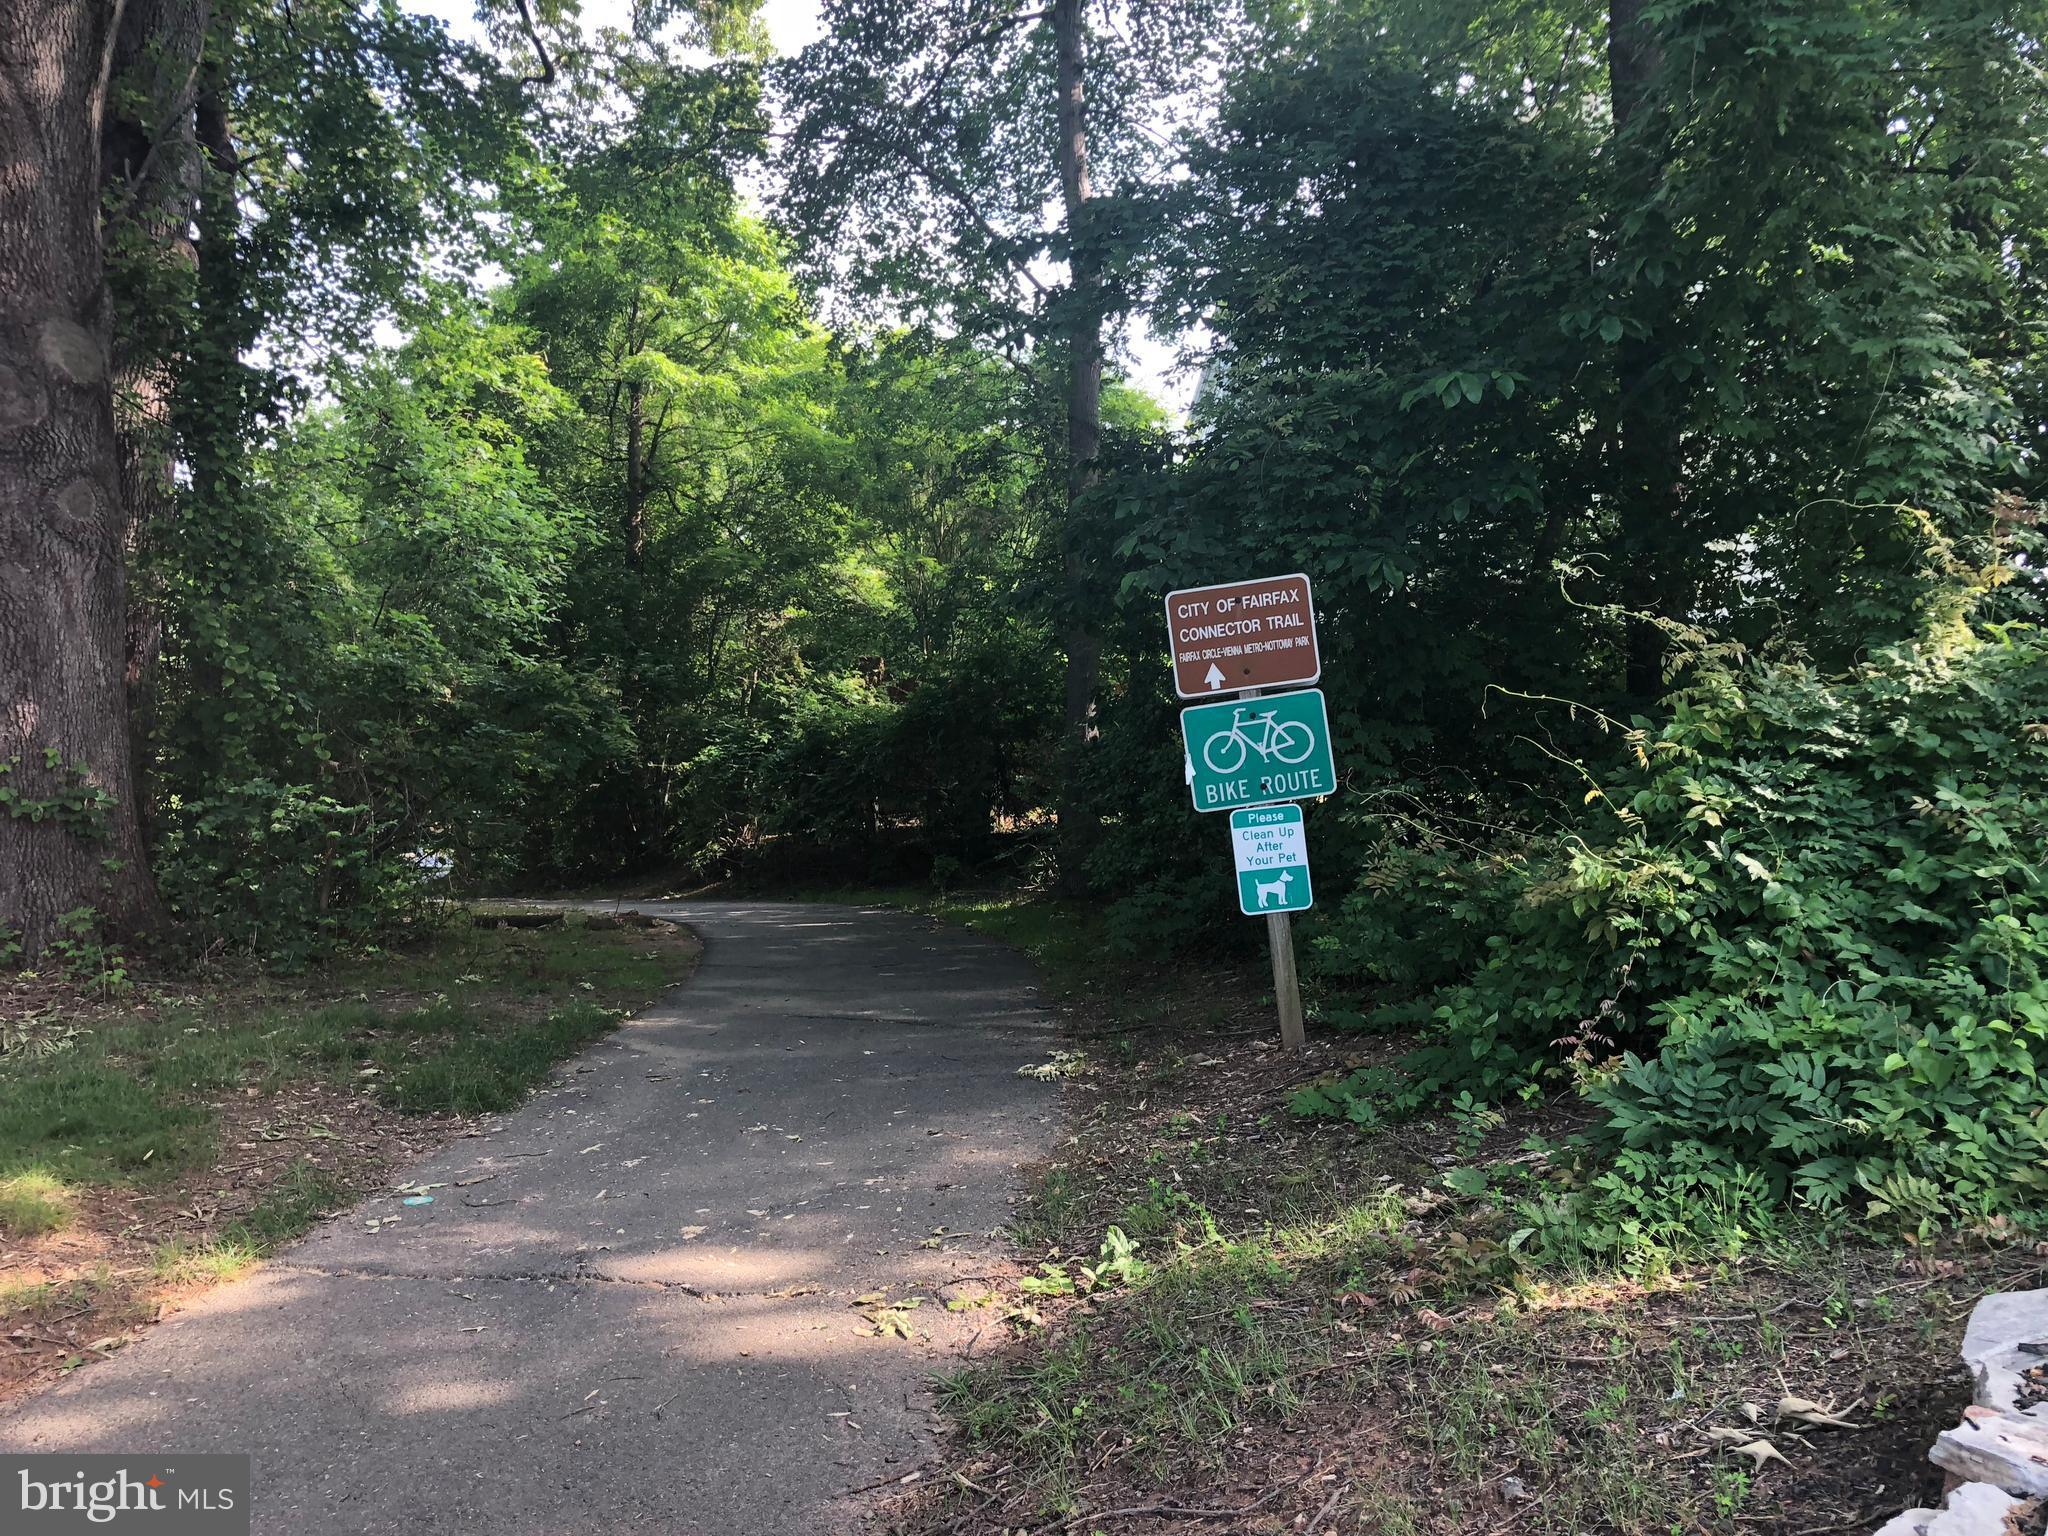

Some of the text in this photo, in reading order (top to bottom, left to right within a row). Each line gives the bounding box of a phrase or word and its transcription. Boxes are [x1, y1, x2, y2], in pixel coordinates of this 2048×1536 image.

[1178, 589, 1300, 619] CITY OF FAIRFAX
[1179, 613, 1304, 643] CONNECTOR TRAIL
[1179, 651, 1201, 663] FAIRFAX
[1295, 636, 1310, 648] PARK
[1205, 768, 1323, 804] BIKE ROUTE
[1248, 812, 1284, 824] Please
[1242, 827, 1295, 841] Clean Up
[1256, 842, 1283, 853] After
[1246, 852, 1297, 866] Your Pet
